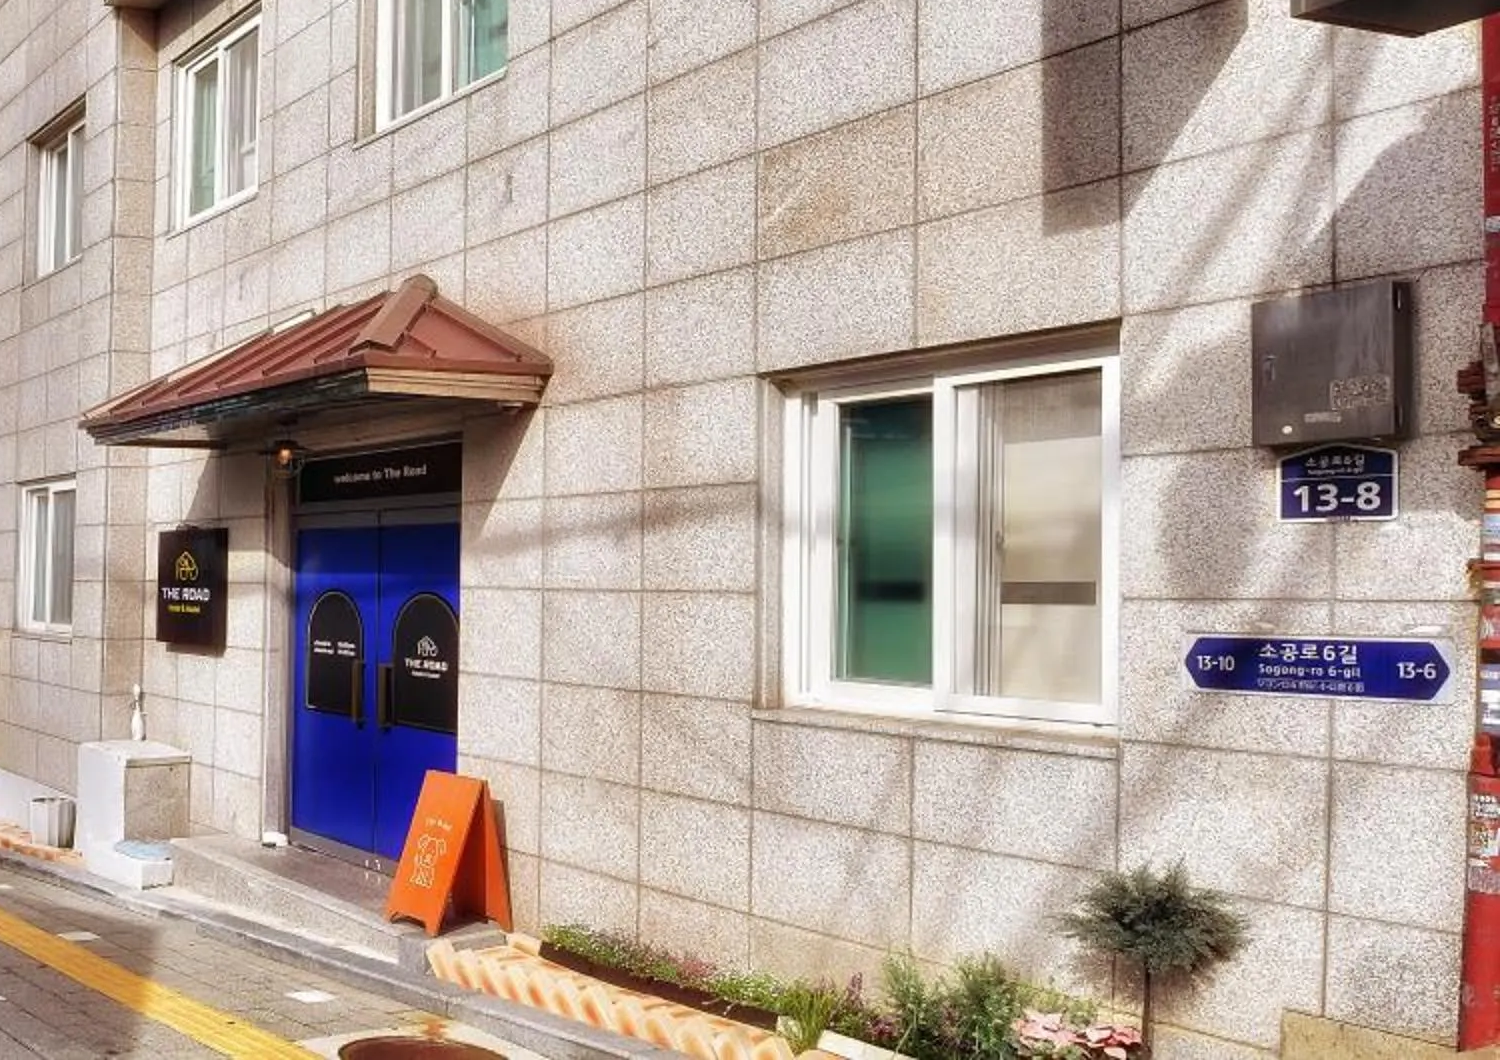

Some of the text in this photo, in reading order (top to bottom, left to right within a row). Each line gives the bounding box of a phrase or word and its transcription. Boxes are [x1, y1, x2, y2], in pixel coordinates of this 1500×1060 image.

[1293, 481, 1381, 513] 13-8
[161, 587, 211, 602] THE ROAD
[1195, 654, 1236, 672] 13-10
[1258, 663, 1324, 678] Sogong-ro
[1396, 661, 1438, 681] 13-6
